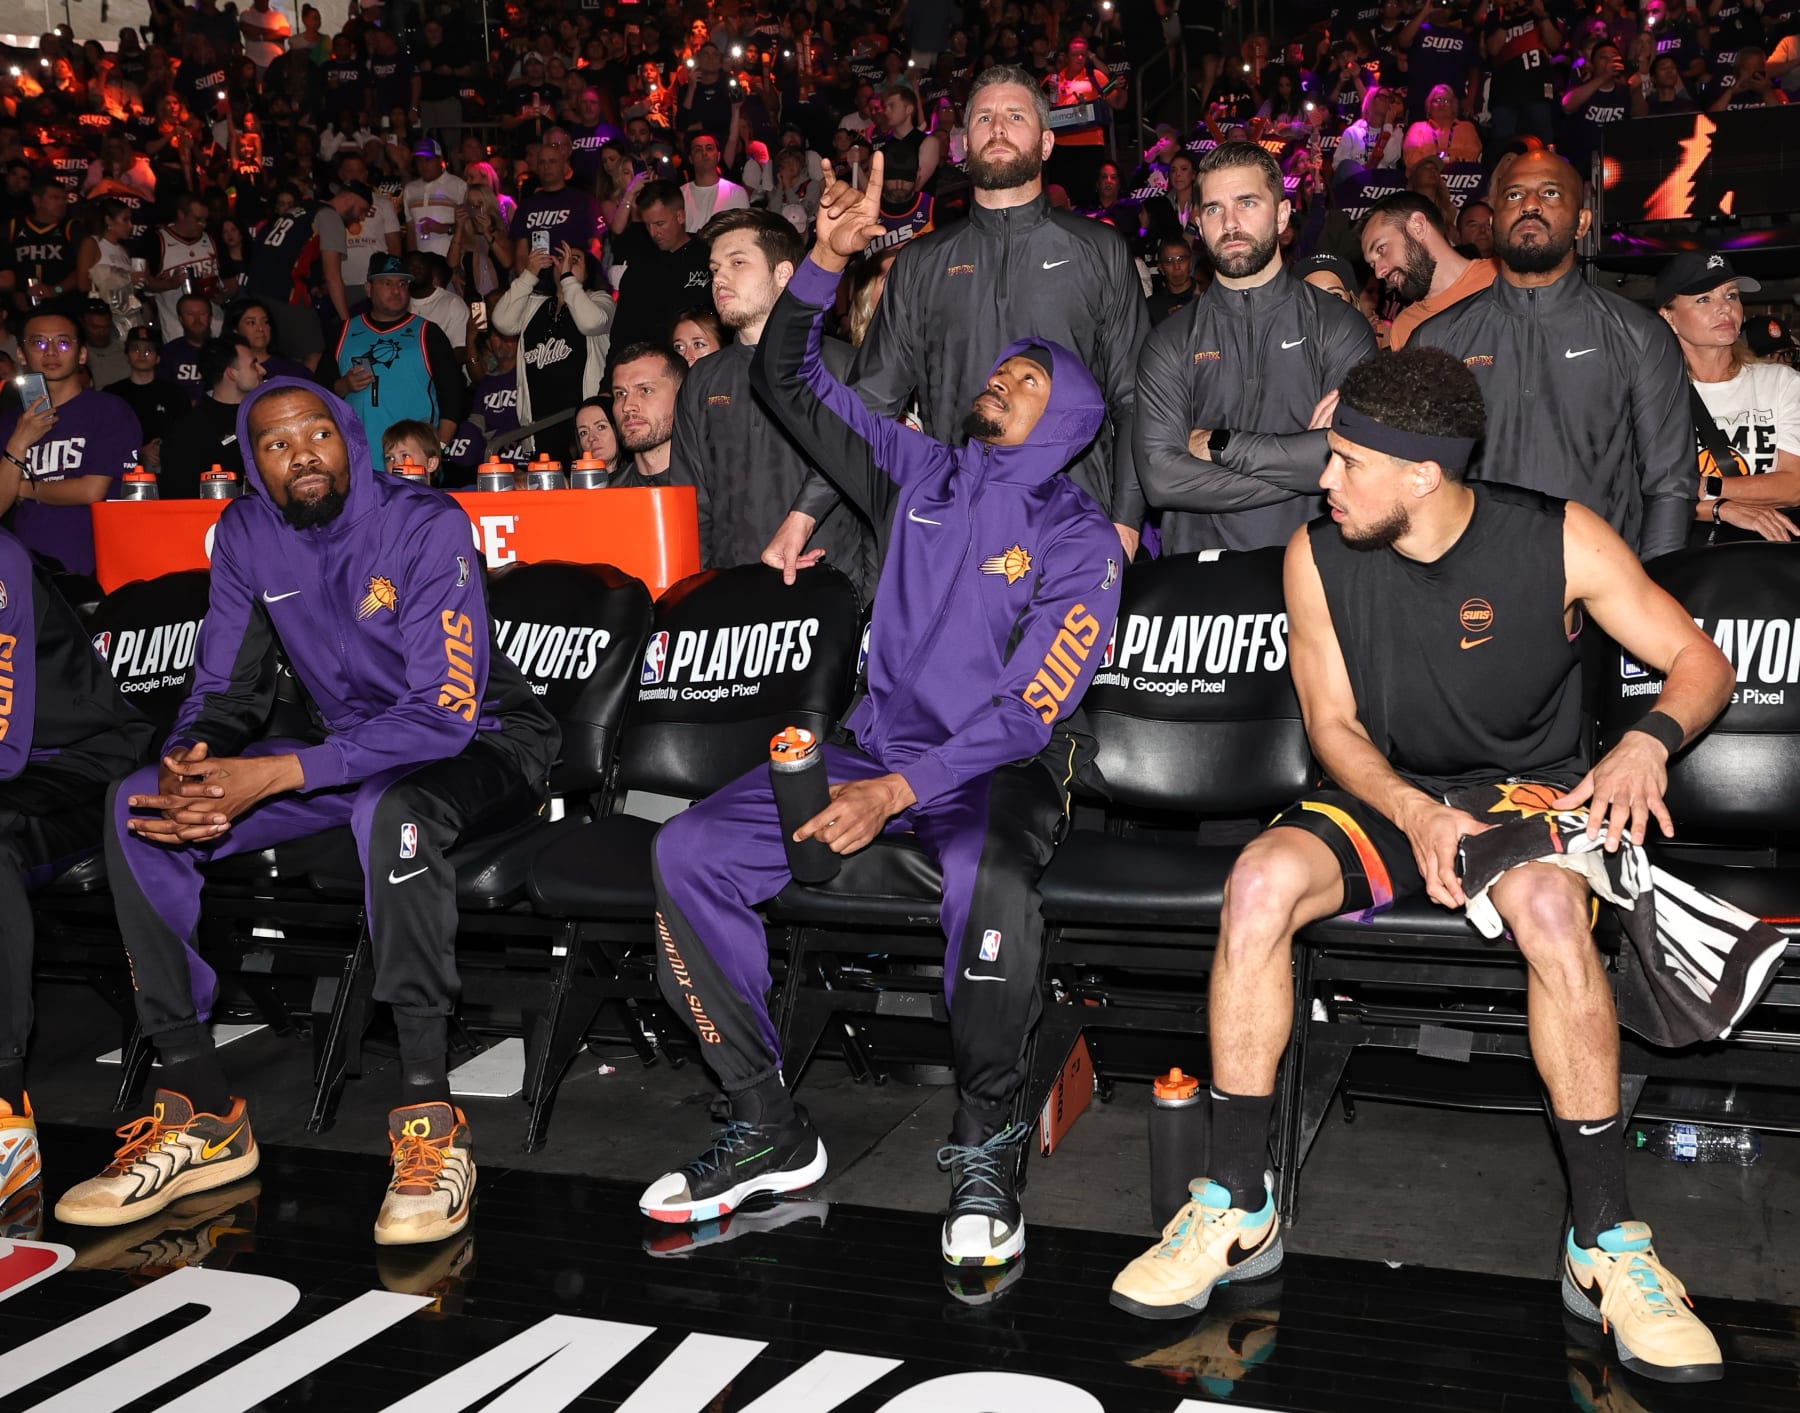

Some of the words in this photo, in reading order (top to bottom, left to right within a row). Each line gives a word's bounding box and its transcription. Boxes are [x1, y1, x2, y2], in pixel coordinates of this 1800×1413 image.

[1421, 34, 1465, 52] SUNS
[1521, 48, 1542, 70] 13
[1585, 105, 1625, 122] SUNS
[572, 136, 611, 150] SUNS
[53, 157, 90, 170] SUNS
[1129, 186, 1169, 201] SUNS
[526, 208, 571, 230] SUNS
[264, 216, 294, 247] 23
[862, 223, 914, 261] SUNS
[15, 243, 65, 263] PHX
[1463, 609, 1490, 621] SUNS
[110, 618, 204, 679] PLAYO
[492, 619, 611, 681] LAYOFFS
[667, 617, 820, 683] PLAYOFFS
[1117, 613, 1290, 674] PLAYOFFS
[437, 609, 478, 722] SUNS
[1022, 603, 1102, 725] SUNS
[119, 679, 160, 694] Google
[161, 673, 186, 687] Pixel
[526, 681, 548, 697] ixel
[638, 688, 665, 702] Presented
[667, 687, 677, 702] by
[680, 686, 730, 702] Google
[731, 682, 760, 697] Pixel
[1120, 675, 1130, 690] by
[1132, 676, 1189, 696] Google
[1190, 679, 1226, 693] Pixel
[1621, 681, 1663, 698] Presented
[1743, 689, 1784, 705] Pixel
